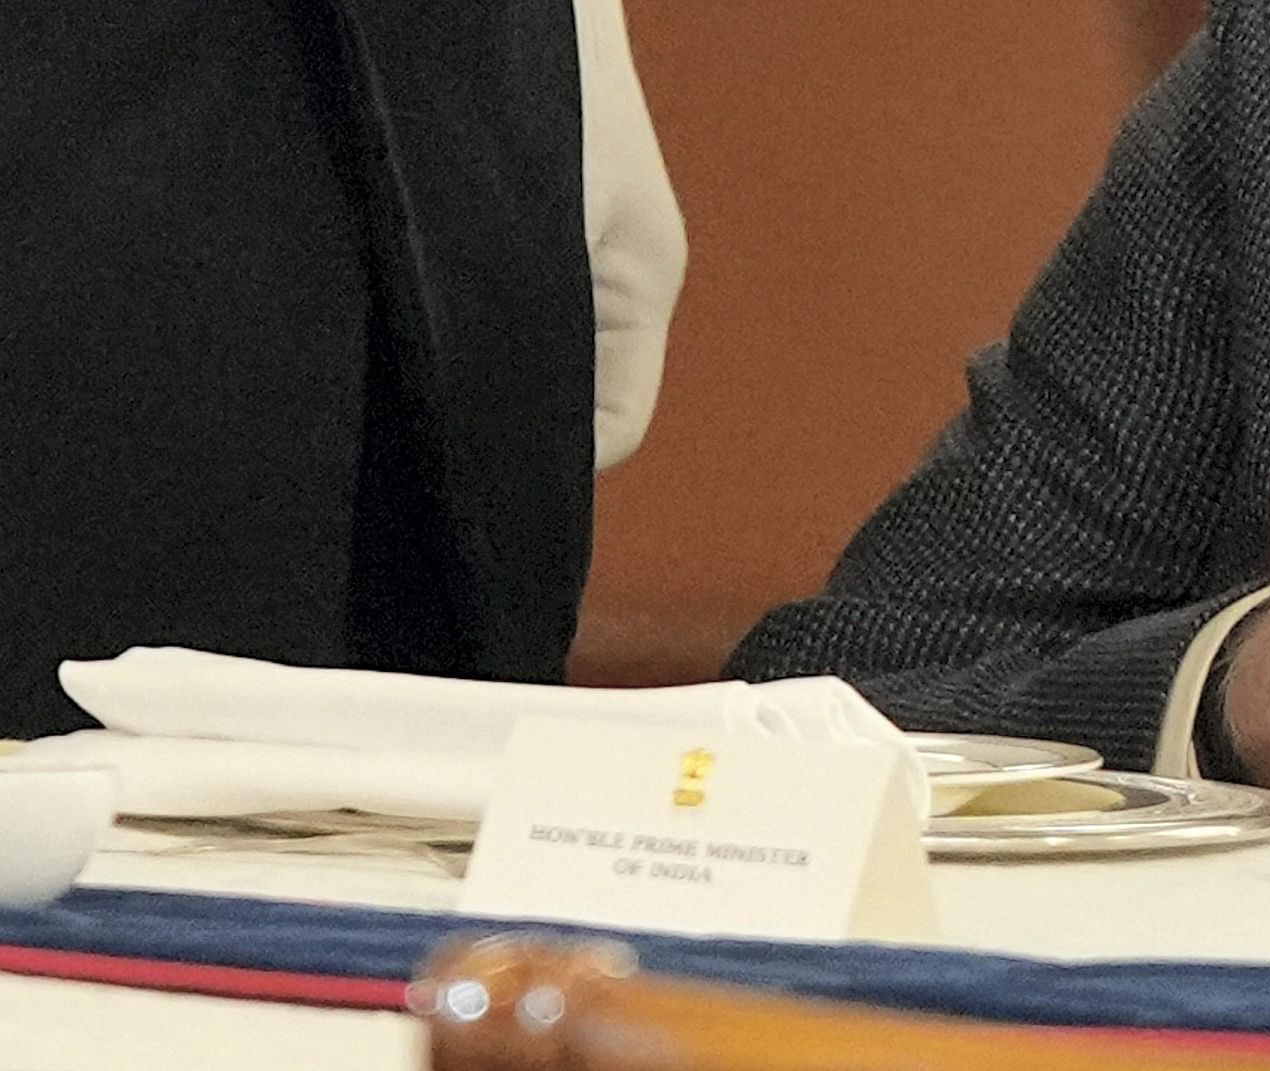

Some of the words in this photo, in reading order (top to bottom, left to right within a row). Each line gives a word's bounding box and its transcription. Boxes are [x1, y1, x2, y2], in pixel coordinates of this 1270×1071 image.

[528, 824, 625, 849] HON'BLE
[631, 834, 698, 858] PRIME
[705, 842, 811, 866] MINISTER
[612, 857, 643, 876] OF
[650, 862, 713, 883] INDIA
